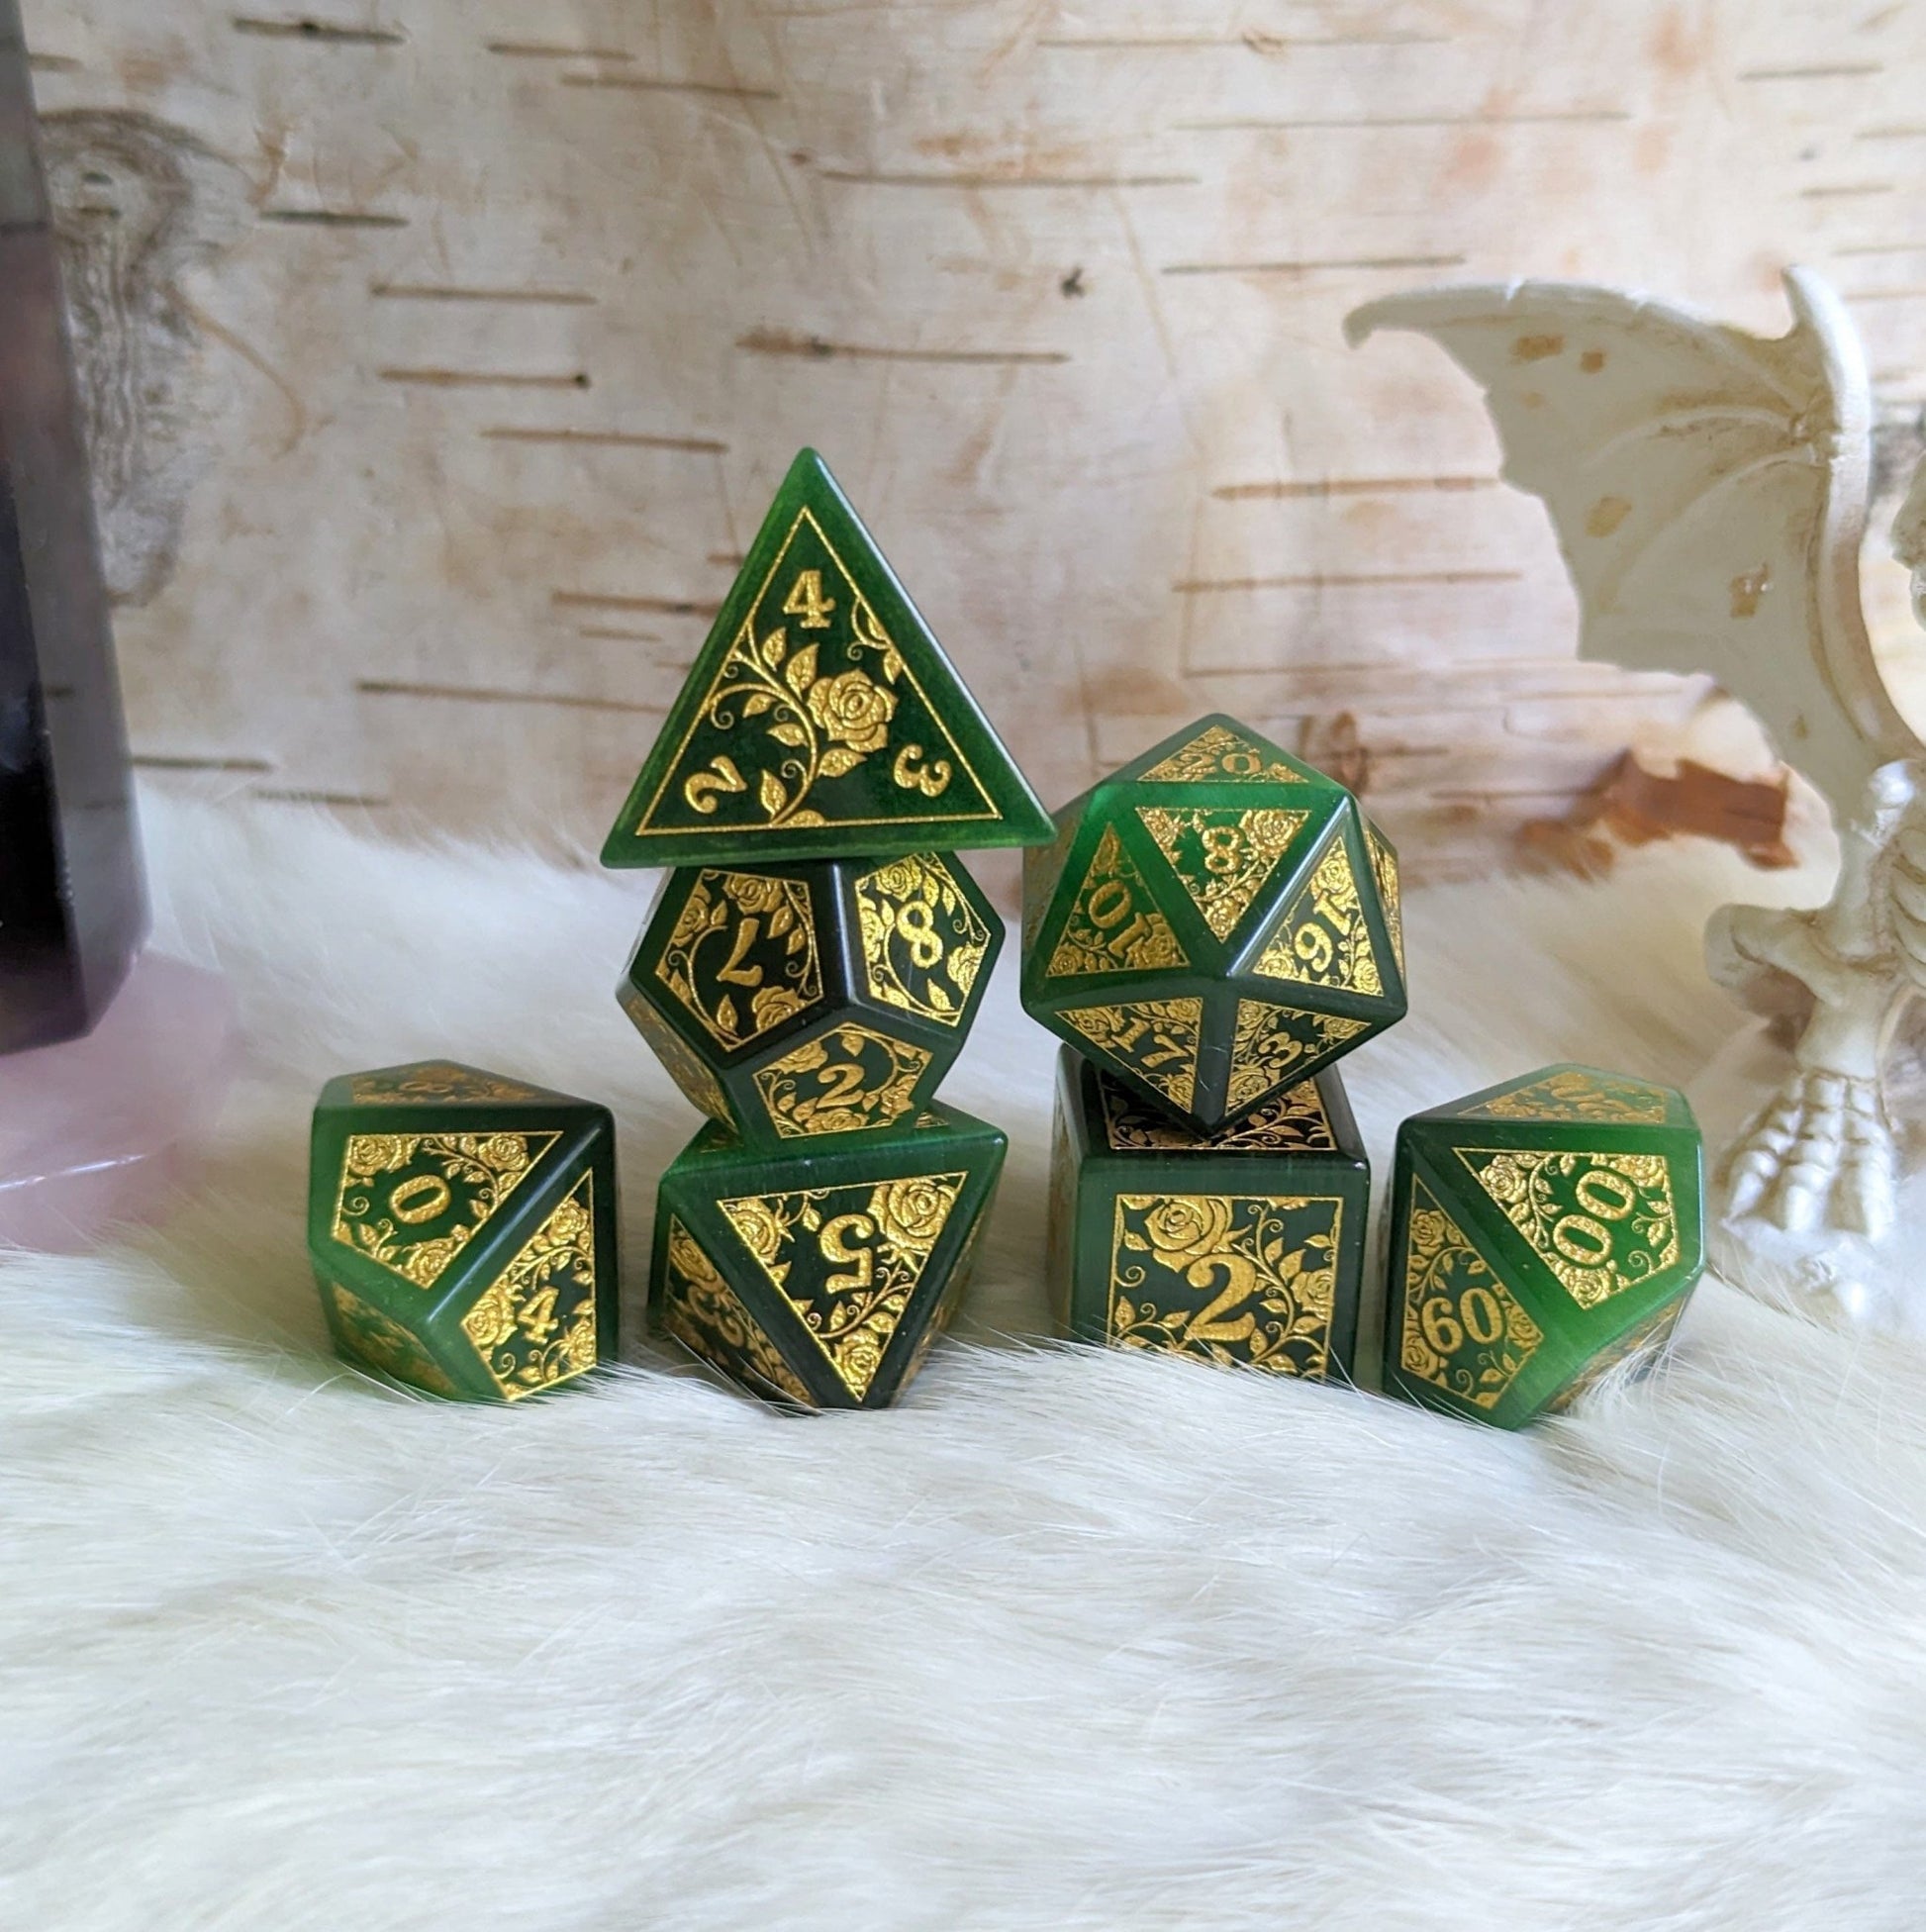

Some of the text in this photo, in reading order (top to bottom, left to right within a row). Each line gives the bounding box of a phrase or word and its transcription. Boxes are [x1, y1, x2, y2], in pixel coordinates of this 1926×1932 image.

[783, 569, 835, 628] 4
[684, 755, 747, 814] 2
[894, 744, 952, 797] 3
[1180, 752, 1261, 774] 20
[1202, 824, 1245, 875] 8
[896, 900, 944, 969] 8
[1088, 879, 1153, 959] 10
[1294, 892, 1353, 974] 16
[716, 918, 763, 987] 7
[1110, 1016, 1188, 1069] 17
[1258, 1031, 1304, 1068] 3
[816, 1063, 865, 1109] 2
[389, 1175, 451, 1224] 0
[1553, 1170, 1635, 1266] 00
[819, 1213, 874, 1295] 5
[517, 1287, 560, 1344] 4
[1184, 1254, 1258, 1342] 2
[1421, 1288, 1503, 1354] 60
